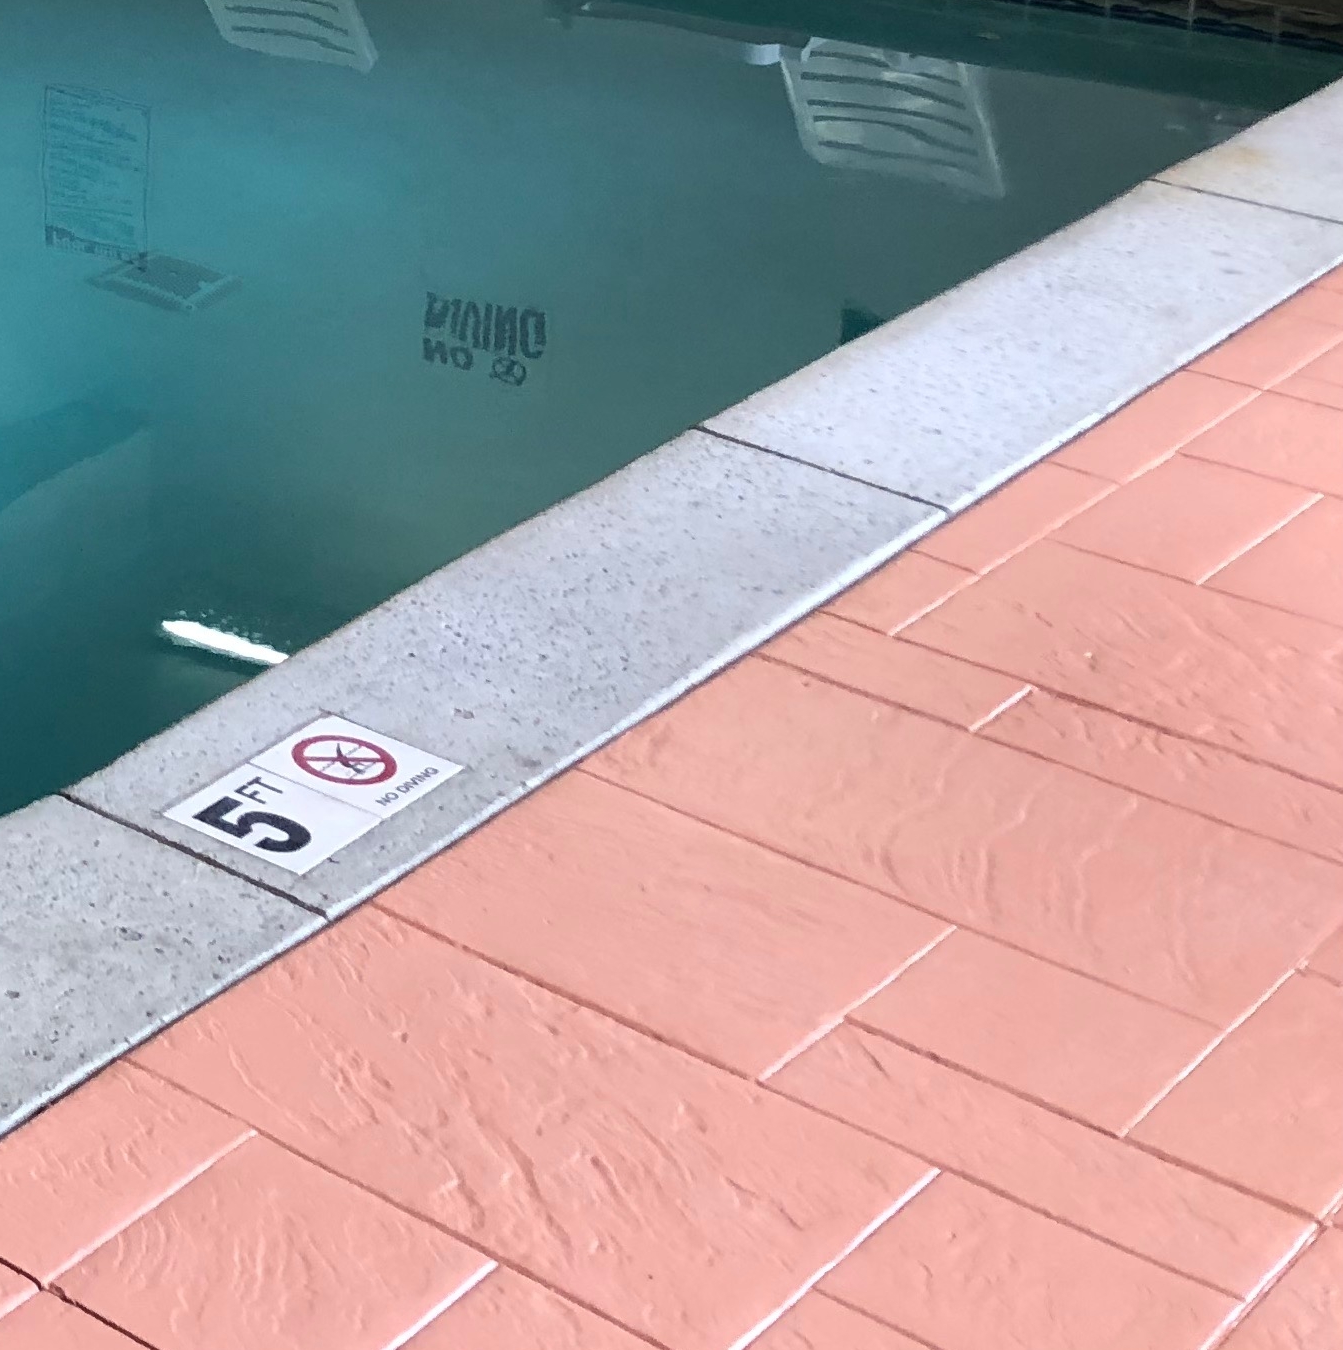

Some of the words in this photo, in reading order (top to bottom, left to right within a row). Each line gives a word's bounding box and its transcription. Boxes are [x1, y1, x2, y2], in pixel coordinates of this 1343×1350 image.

[234, 776, 284, 805] FT
[375, 788, 400, 807] NO
[395, 766, 440, 797] DIVING
[192, 795, 312, 853] 5
